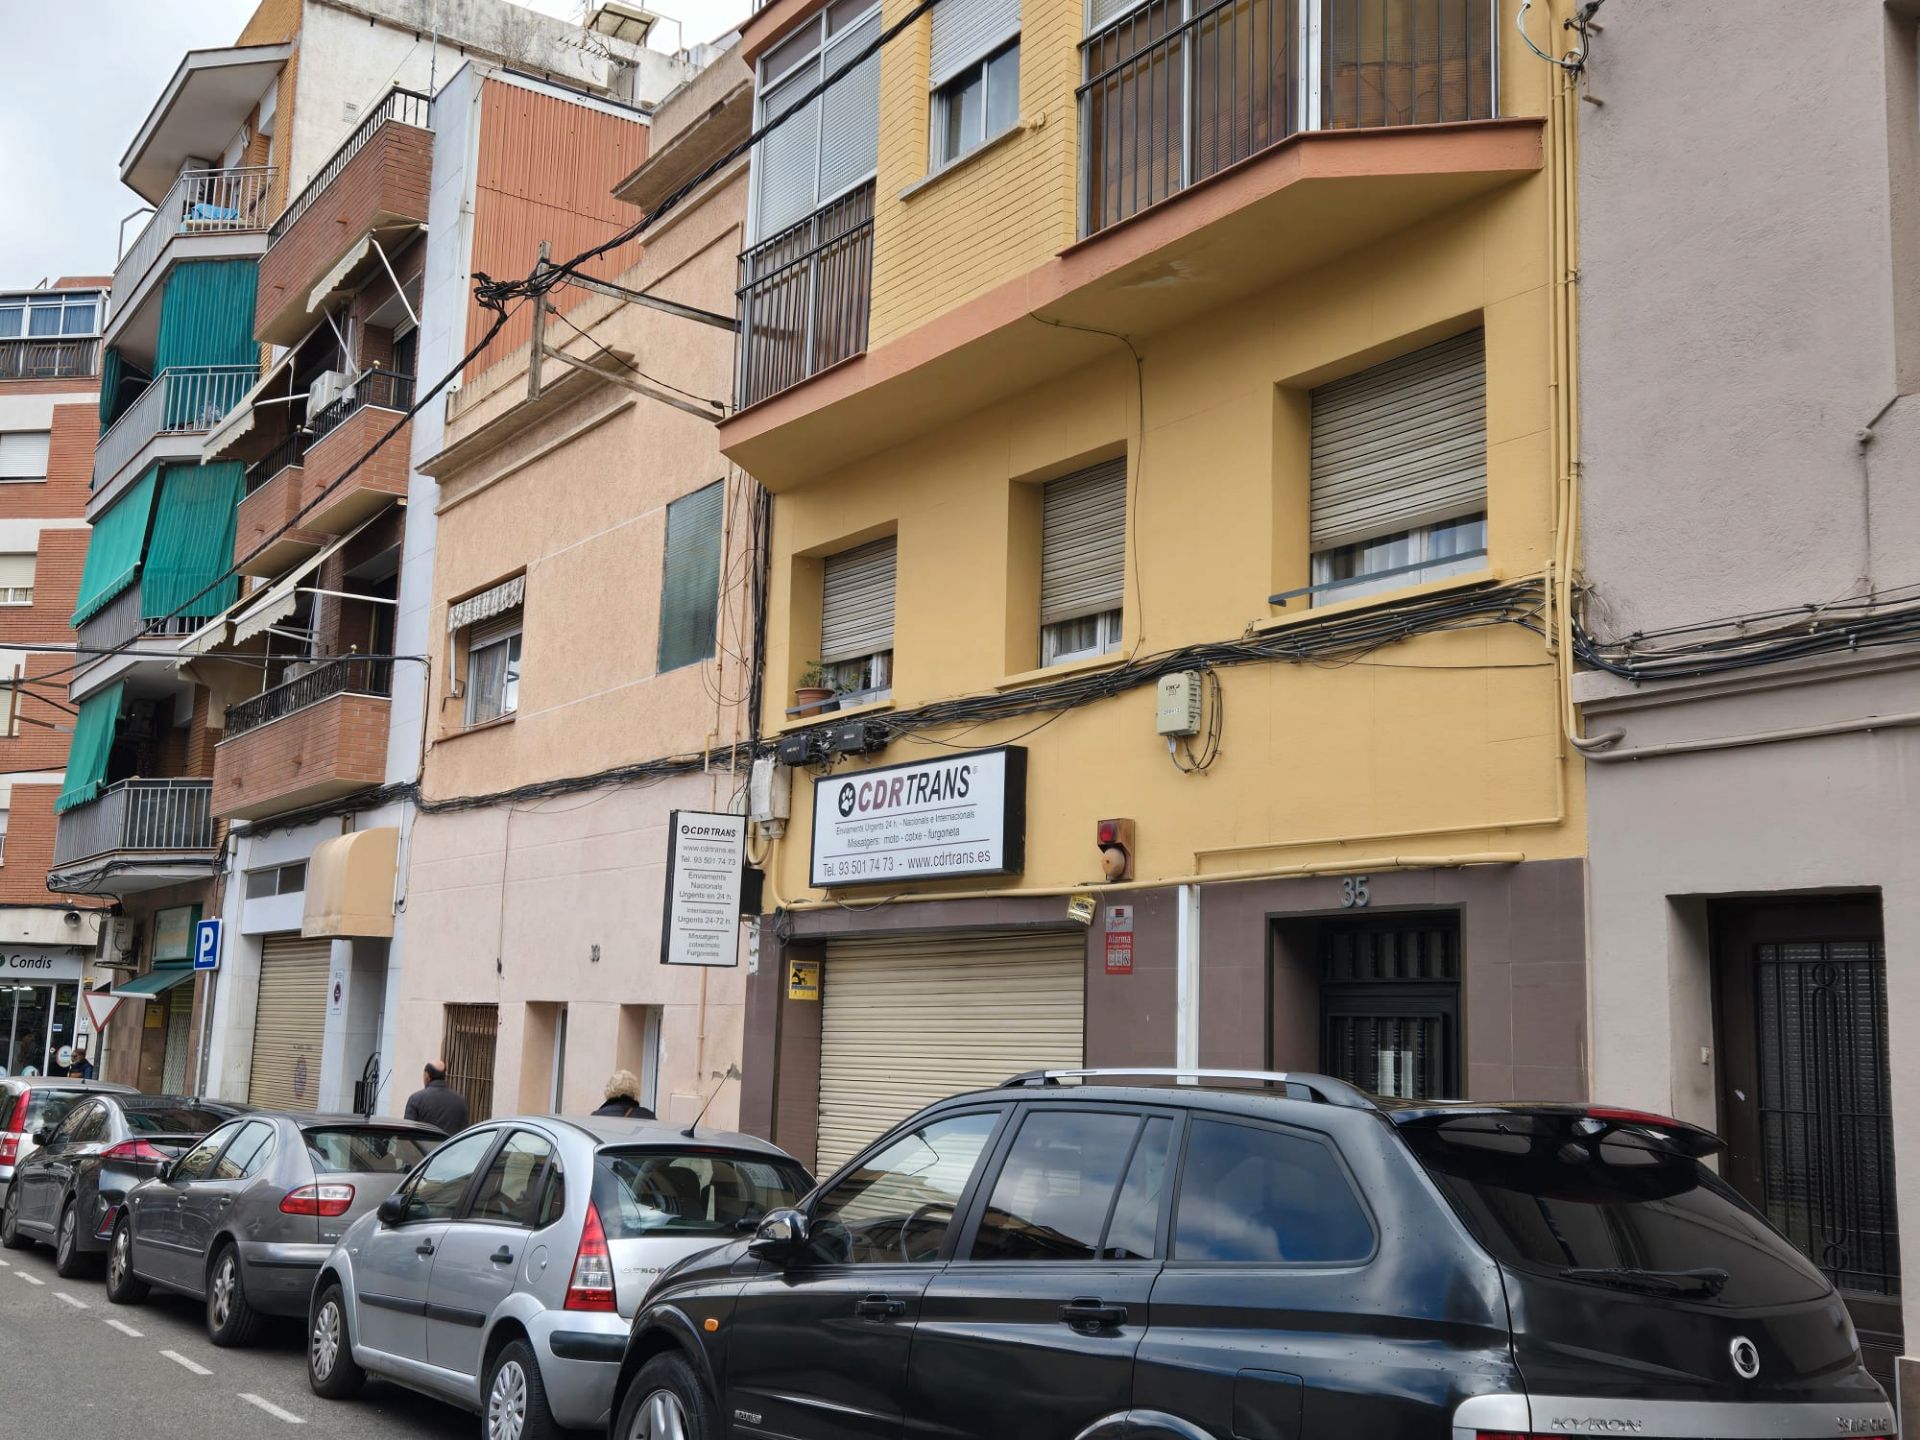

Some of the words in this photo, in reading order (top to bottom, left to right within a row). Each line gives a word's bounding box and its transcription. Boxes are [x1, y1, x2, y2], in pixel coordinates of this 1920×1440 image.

[885, 820, 892, 829] 24
[884, 834, 900, 845] moto
[928, 827, 960, 841] furgoneta
[694, 856, 703, 864] 93
[704, 856, 716, 865] 501
[728, 858, 736, 866] 73
[839, 861, 849, 876] 93
[852, 859, 866, 875] 501
[870, 858, 880, 872] 74
[883, 856, 894, 871] 73
[907, 849, 991, 869] www.cdrtrans.es
[690, 882, 723, 890] Nacionals
[1341, 876, 1369, 908] 35
[680, 890, 705, 899] Urgents
[678, 916, 704, 924] Urgents
[199, 926, 214, 962] P
[1108, 936, 1132, 944] Alarma
[9, 954, 52, 969] Condis
[1551, 1416, 1642, 1433] KYRON
